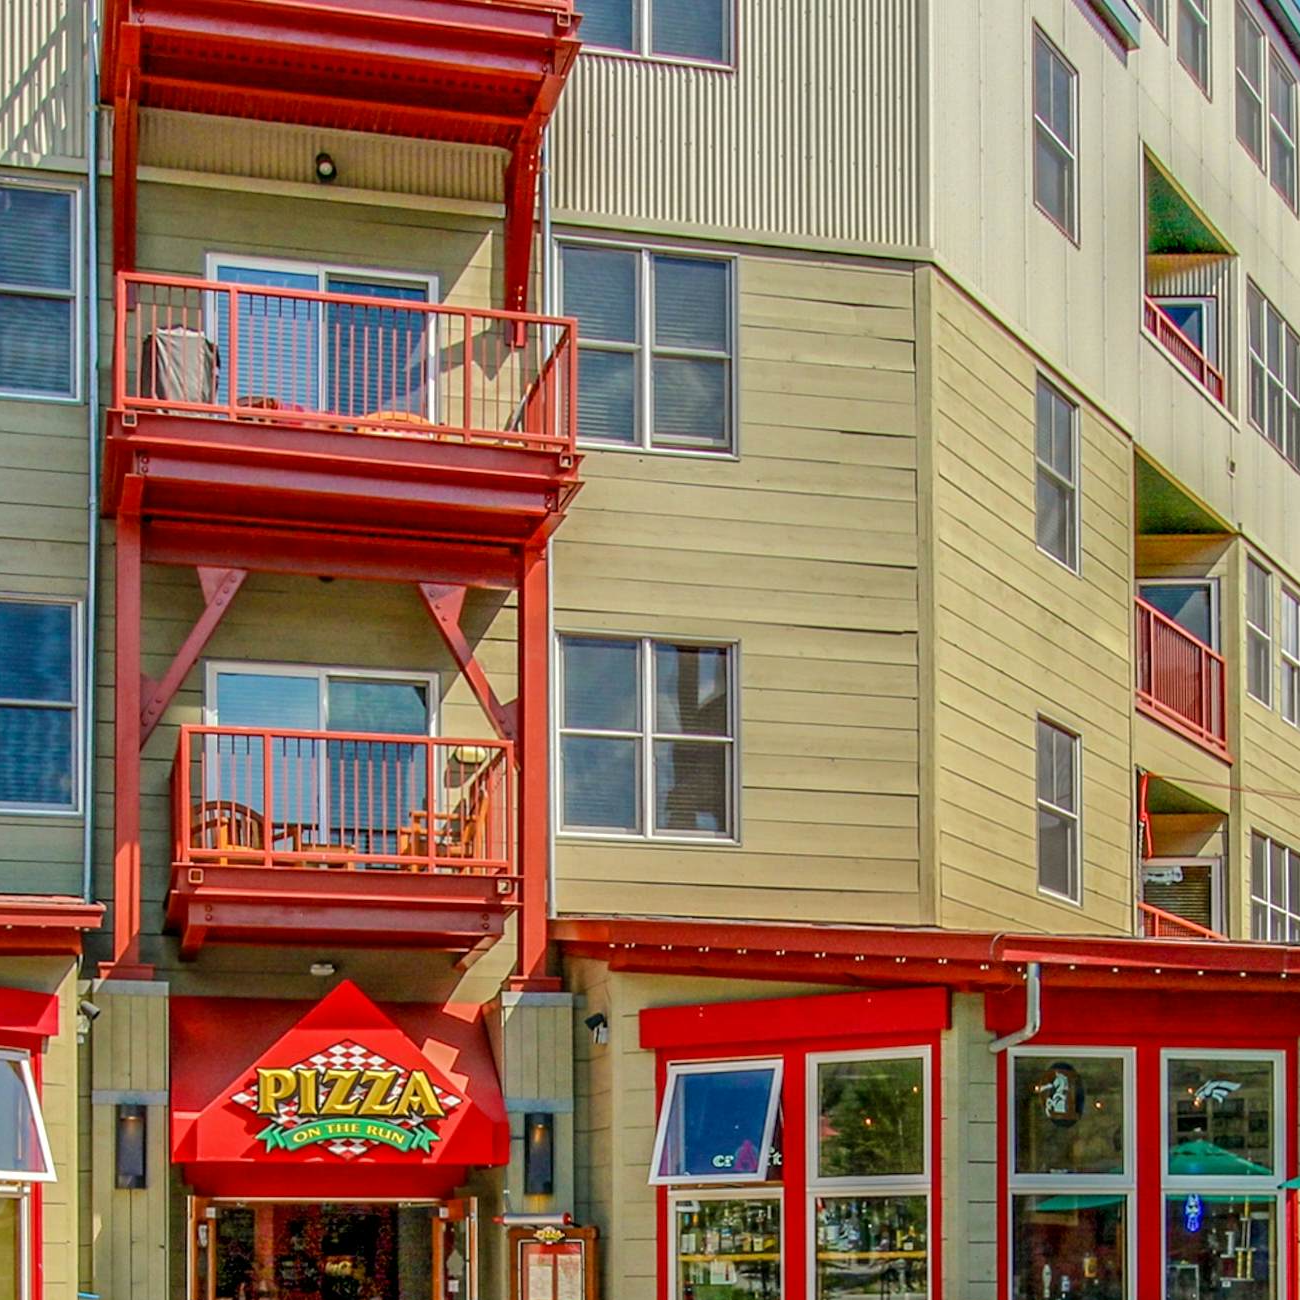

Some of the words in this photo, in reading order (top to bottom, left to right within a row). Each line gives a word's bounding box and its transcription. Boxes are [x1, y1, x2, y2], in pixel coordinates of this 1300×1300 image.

[256, 1068, 446, 1117] PIZZA
[292, 1129, 321, 1143] ON
[324, 1123, 361, 1135] THE
[366, 1124, 406, 1145] RUN
